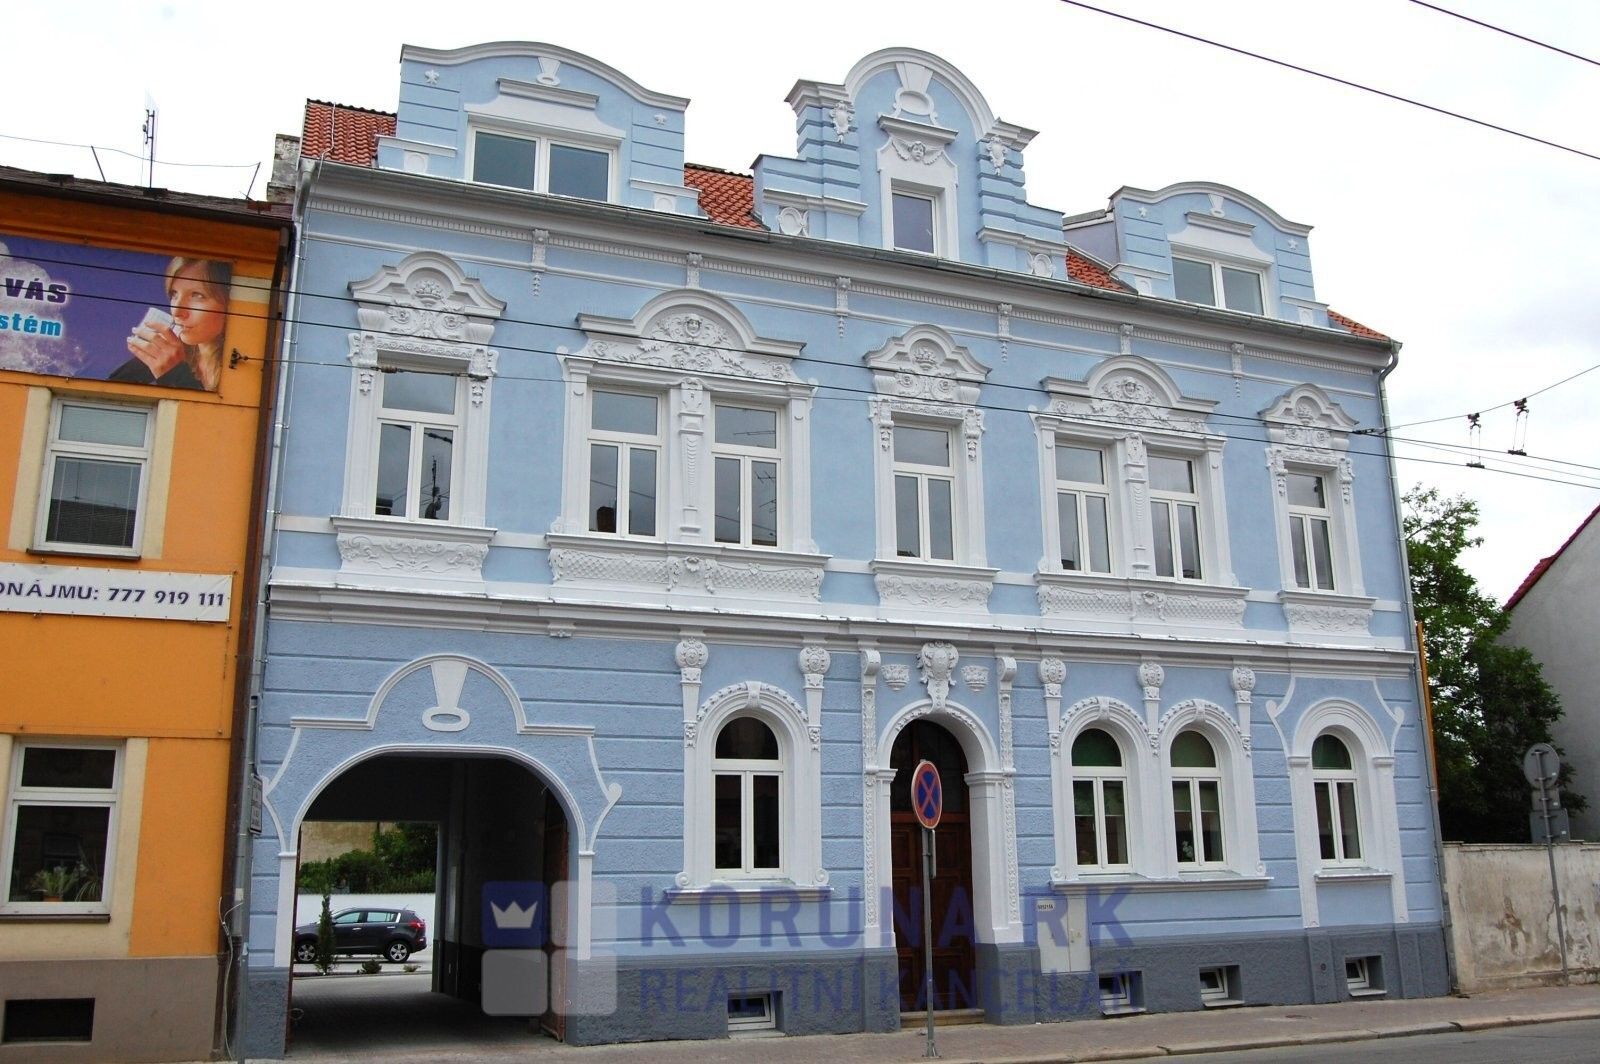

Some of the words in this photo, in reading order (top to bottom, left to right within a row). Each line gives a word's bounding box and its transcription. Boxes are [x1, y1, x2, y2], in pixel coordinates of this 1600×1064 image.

[5, 277, 68, 304] VÁS
[108, 588, 146, 602] 777
[154, 590, 189, 605] 919
[199, 593, 224, 606] 111
